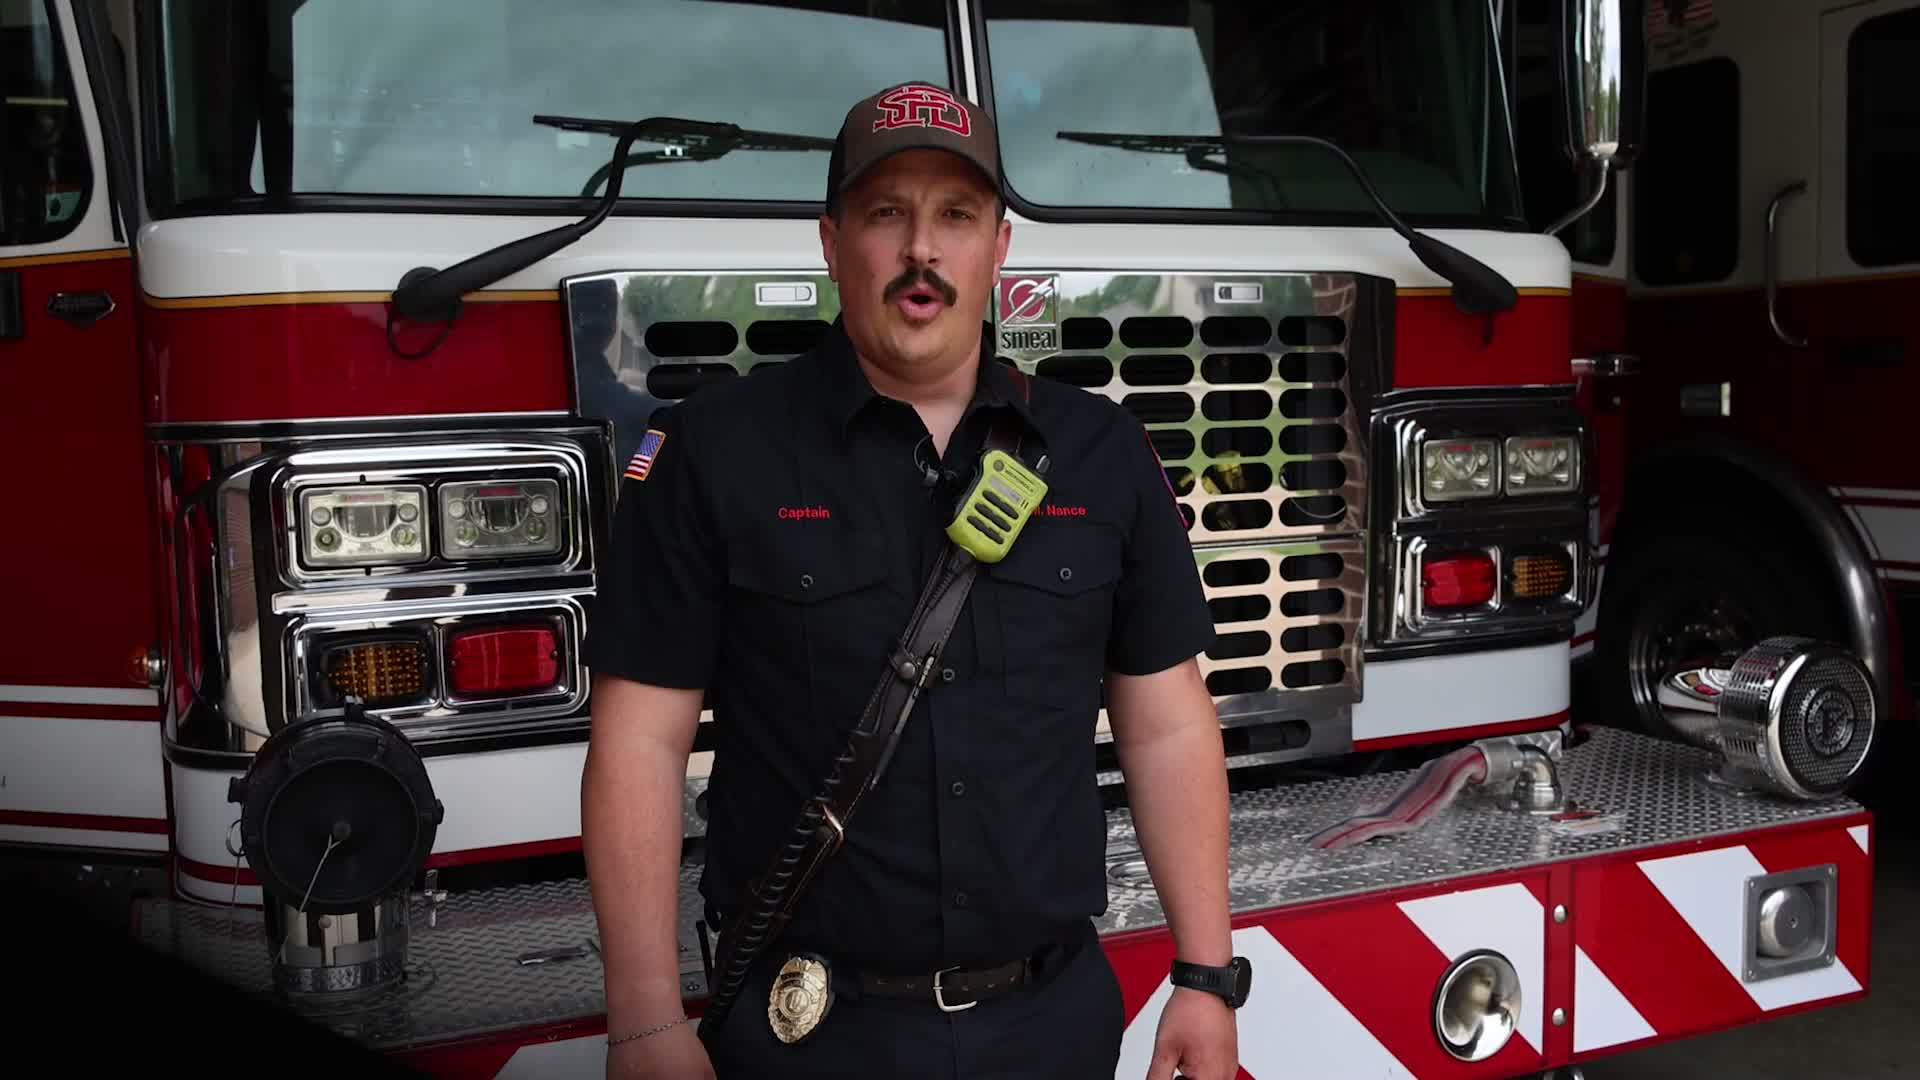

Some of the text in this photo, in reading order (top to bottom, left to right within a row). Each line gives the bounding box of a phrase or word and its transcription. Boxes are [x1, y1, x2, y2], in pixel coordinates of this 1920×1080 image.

[1002, 329, 1057, 349] smeal
[778, 506, 831, 520] Captain
[1047, 504, 1087, 516] Nance
